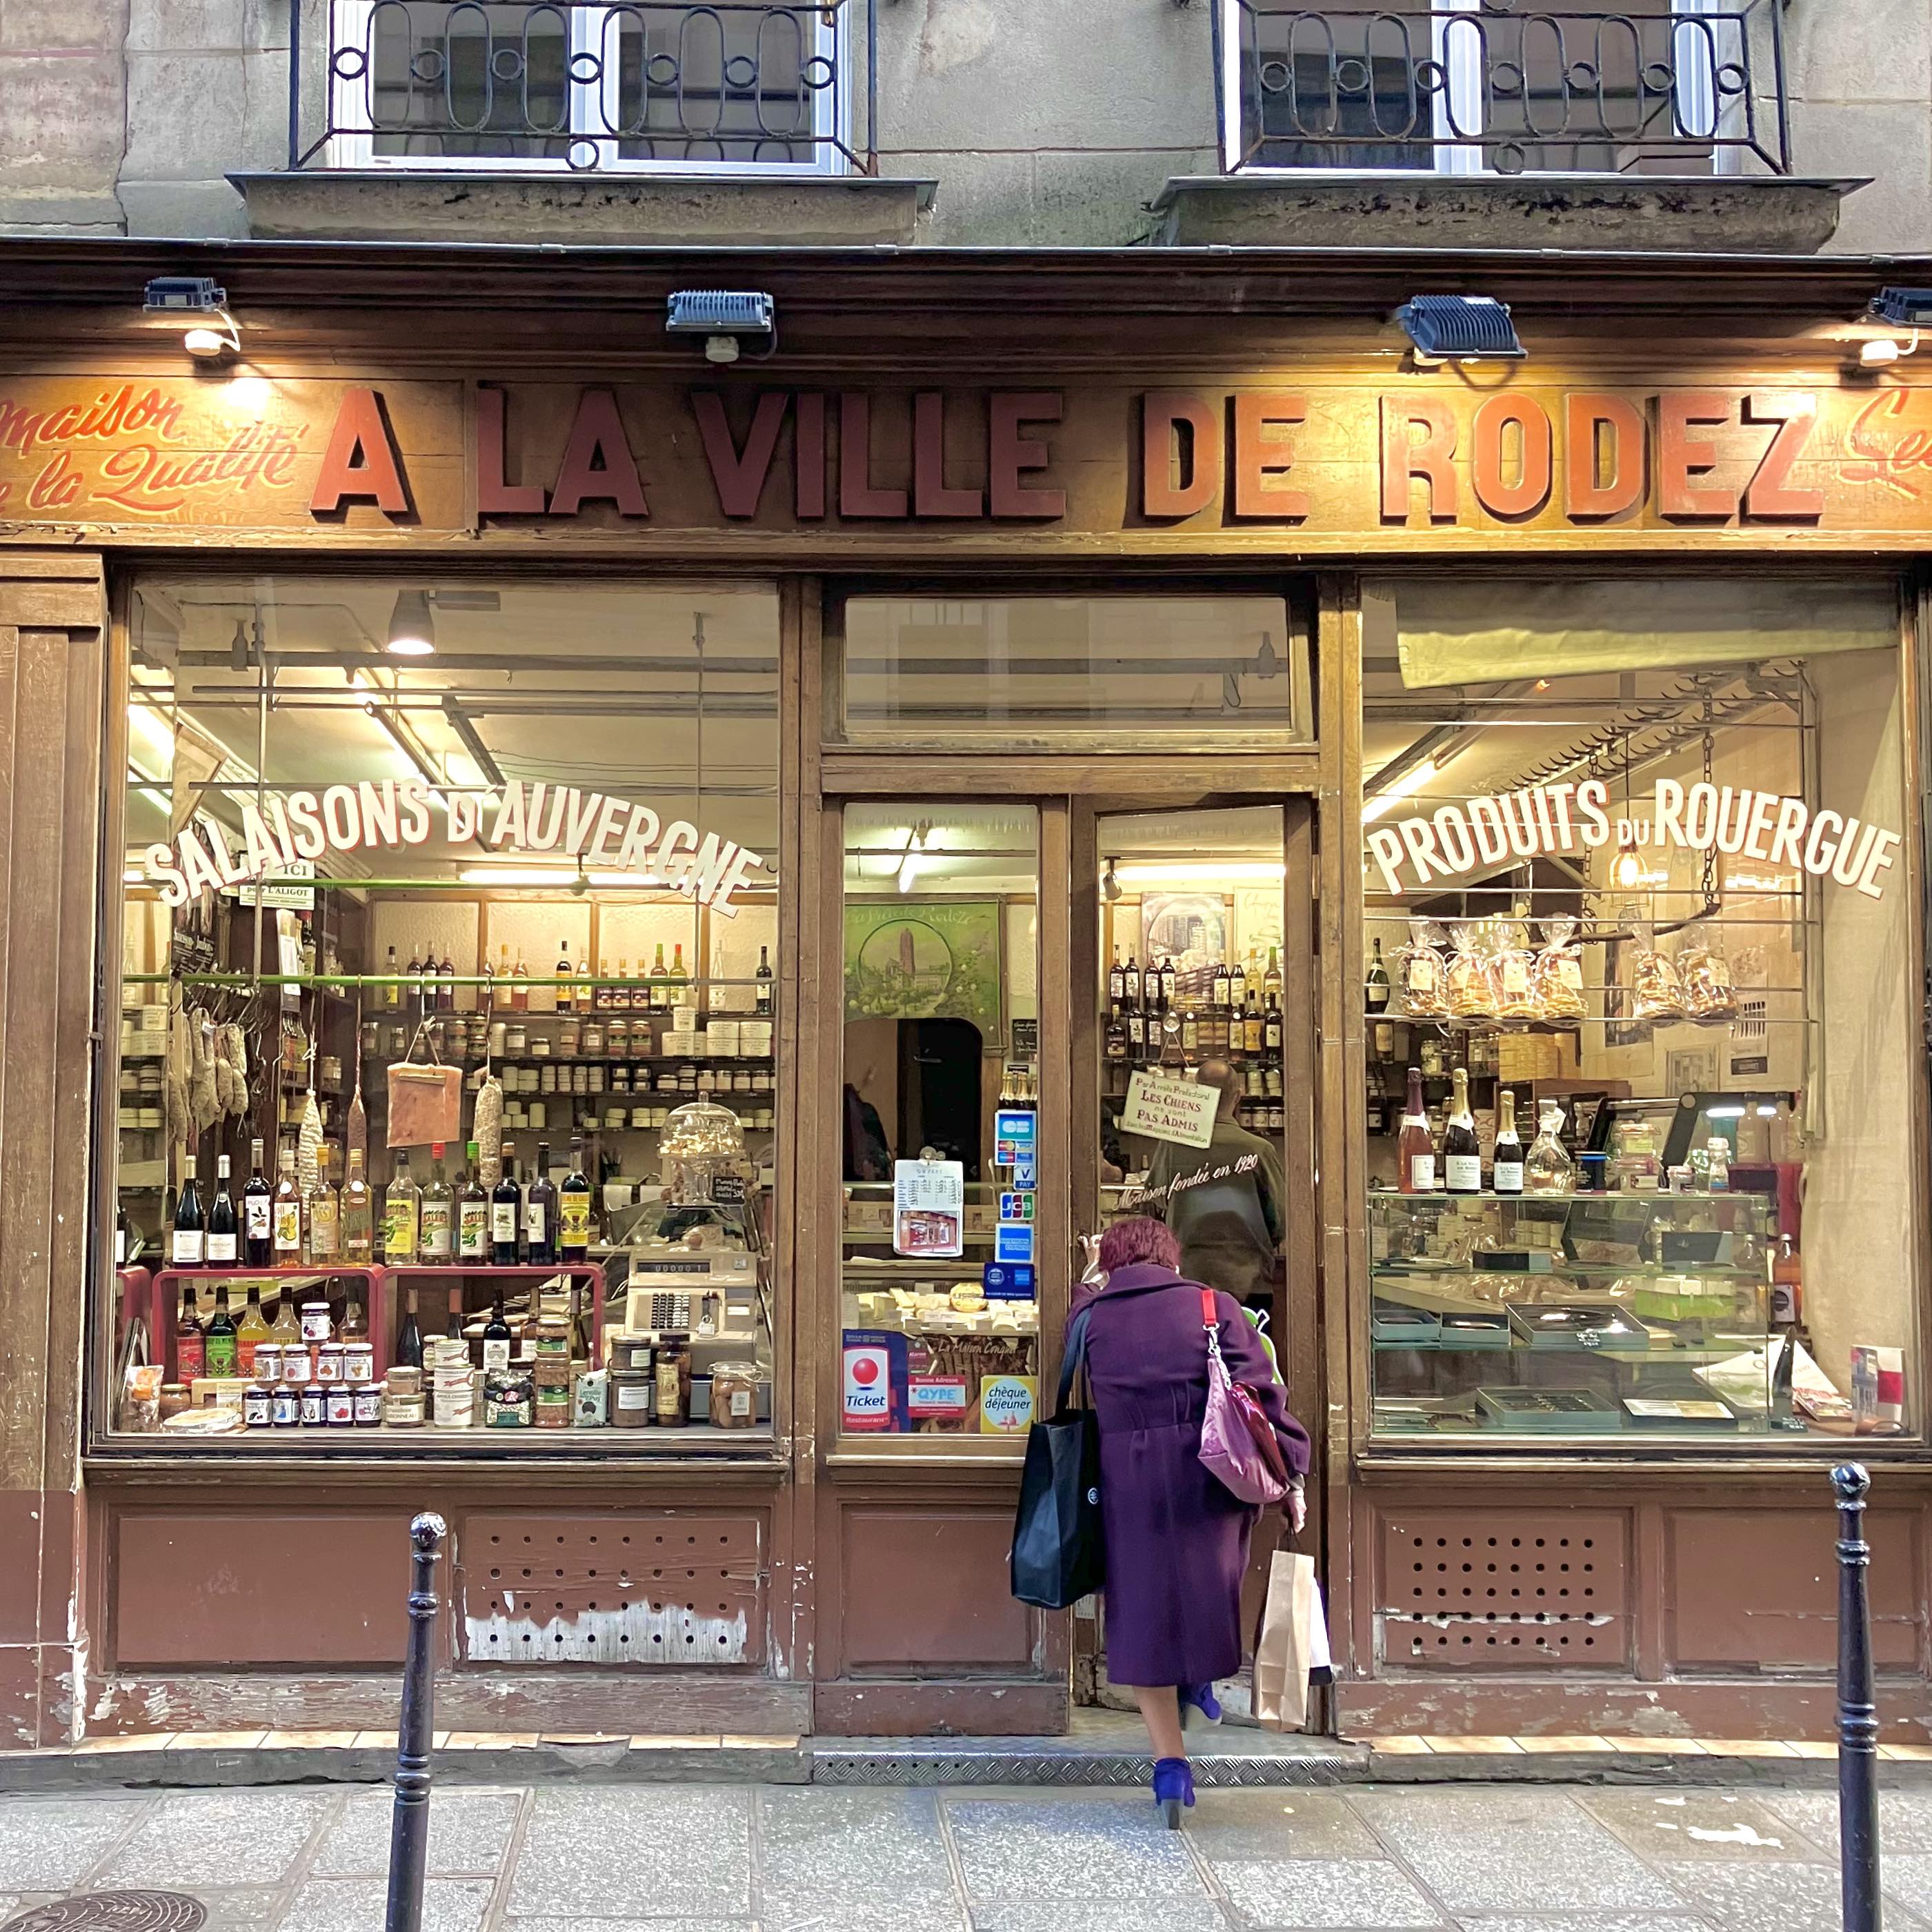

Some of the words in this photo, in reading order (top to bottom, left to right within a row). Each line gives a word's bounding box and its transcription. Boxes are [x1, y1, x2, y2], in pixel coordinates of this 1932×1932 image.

[308, 386, 410, 517] A
[476, 386, 649, 516] LA
[692, 391, 1067, 519] VILLE
[1143, 392, 1307, 518] DE
[1380, 391, 1824, 521] RODEZ
[88, 422, 310, 516] Qualité
[144, 777, 430, 908] SALAISONS
[1366, 779, 1610, 896] PRODUITS
[1617, 818, 1650, 846] DU
[1655, 778, 1902, 899] ROUERGUE
[268, 886, 308, 897] L'ALIGOT
[1141, 1090, 1162, 1104] LES
[1164, 1095, 1202, 1113] CHIENS
[1154, 1105, 1164, 1113] ne
[1168, 1108, 1186, 1117] sont
[1136, 1109, 1159, 1123] PAS
[1161, 1114, 1199, 1132] ADMIS
[1112, 1182, 1166, 1211] Maison
[1167, 1162, 1211, 1199] fondée
[1213, 1164, 1231, 1179] en
[1234, 1154, 1259, 1174] 1920
[1002, 1202, 1032, 1211] JCB
[952, 1340, 982, 1353] Maison
[917, 1388, 957, 1400] QYPE
[988, 1386, 1027, 1400] chèque
[846, 1395, 886, 1406] Ticket
[985, 1398, 1032, 1411] déjeuner
